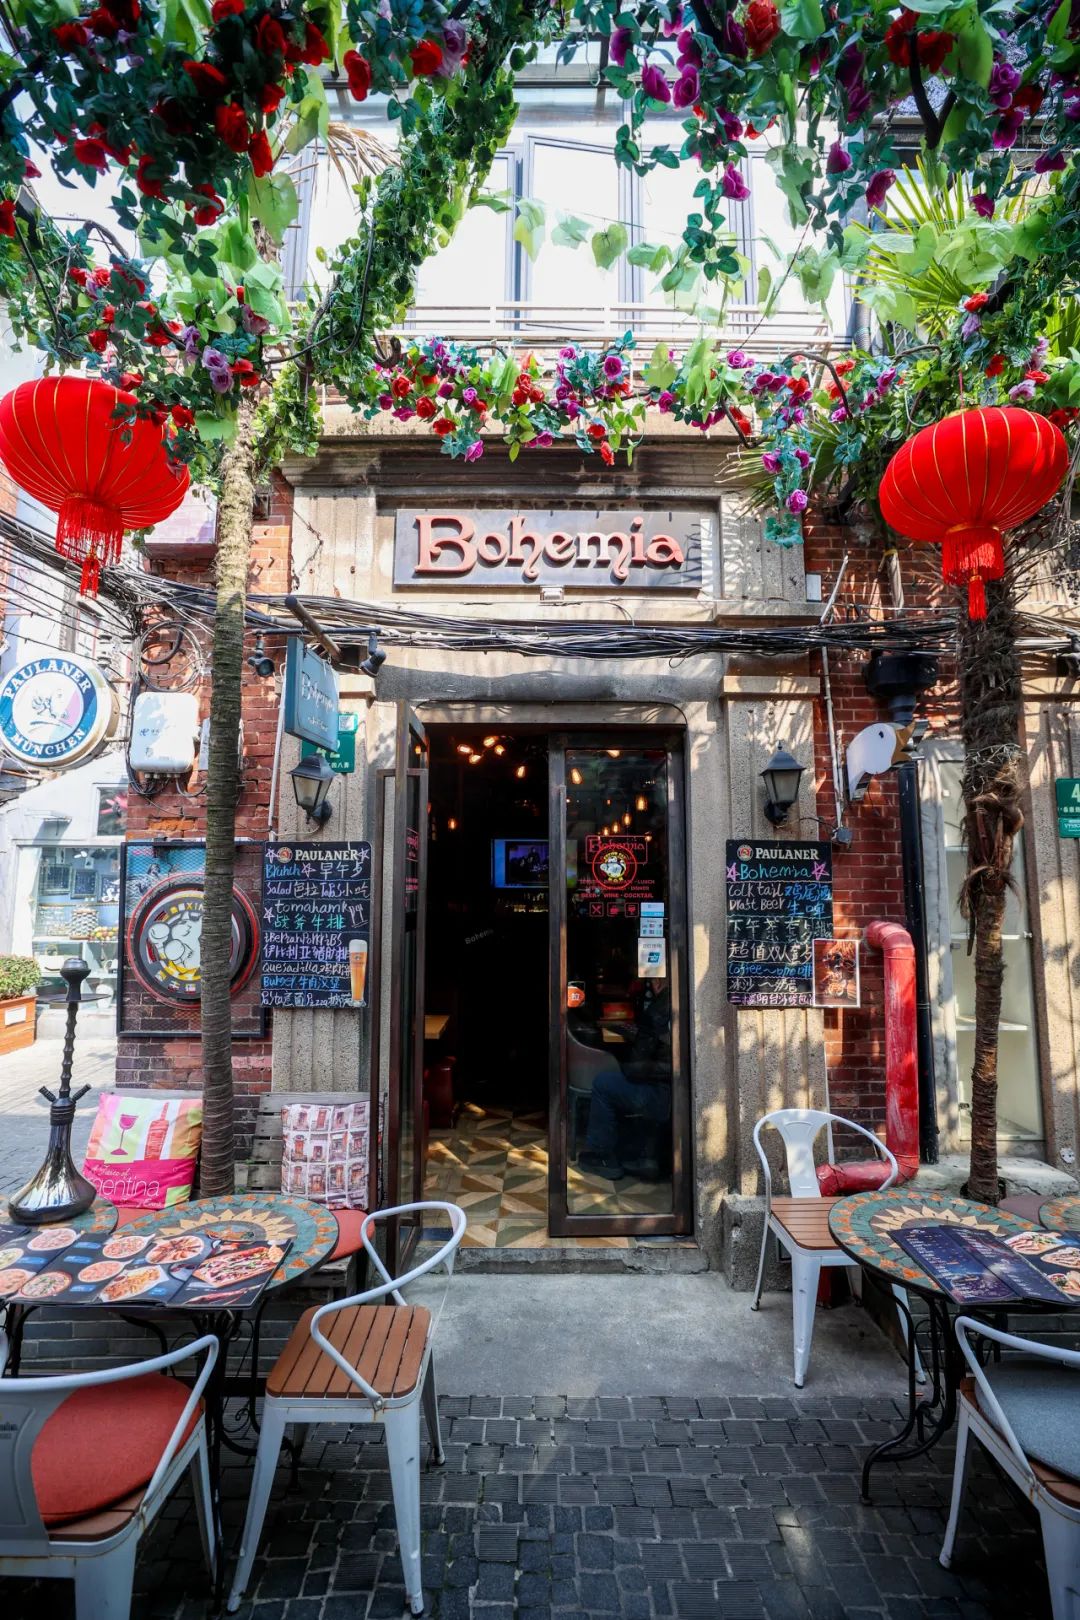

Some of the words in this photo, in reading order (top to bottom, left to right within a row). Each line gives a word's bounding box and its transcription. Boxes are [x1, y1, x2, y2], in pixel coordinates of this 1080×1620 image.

[413, 514, 685, 581] Bohemia
[3, 658, 92, 700] PAULANER
[295, 850, 359, 861] PAULANER
[755, 847, 820, 860] PAULANER
[265, 863, 301, 879] Brunch
[740, 863, 812, 880] Bohemia
[294, 881, 319, 898] 色拉
[343, 883, 371, 898] 小吃
[785, 882, 832, 901] 鸡尾酒
[788, 901, 826, 917] 生啤
[274, 915, 345, 932] 战斧牛排
[299, 975, 341, 991] 牛肉汉堡
